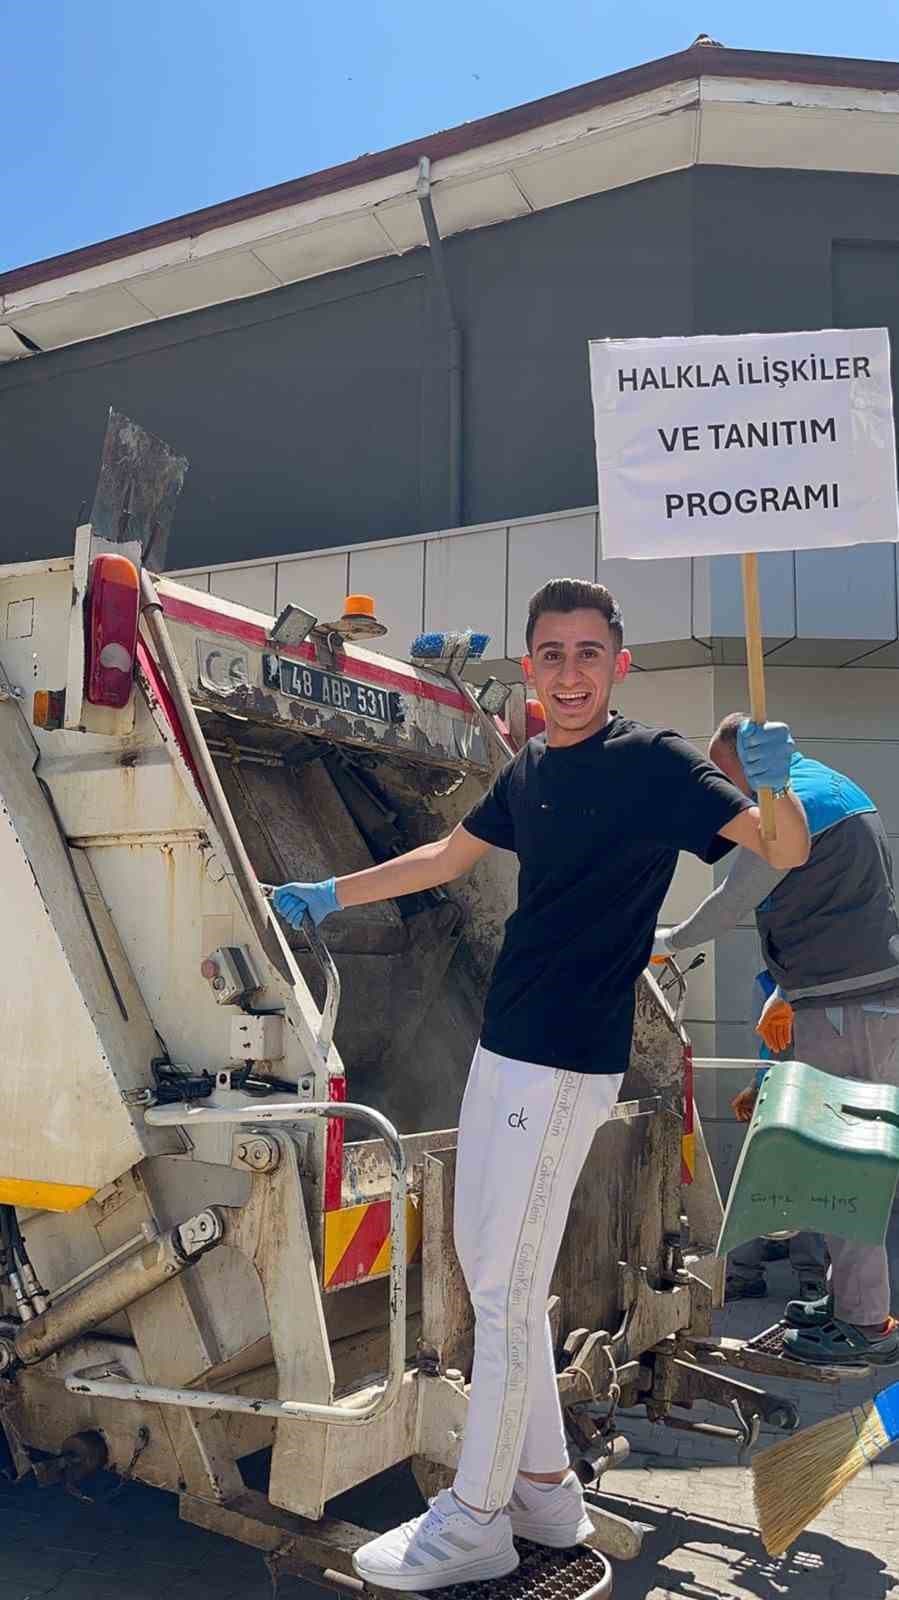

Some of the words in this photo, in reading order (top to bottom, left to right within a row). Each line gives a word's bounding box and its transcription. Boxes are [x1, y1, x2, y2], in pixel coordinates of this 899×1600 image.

[617, 364, 730, 392] HALKLA
[737, 353, 871, 388] İLİŞKİLER
[658, 426, 700, 452] VE
[708, 417, 837, 450] TANITIM
[665, 483, 839, 519] PROGRAMI
[292, 666, 313, 697] 48
[322, 676, 352, 707] ABP
[357, 686, 385, 719] 531
[507, 1107, 529, 1131] ck
